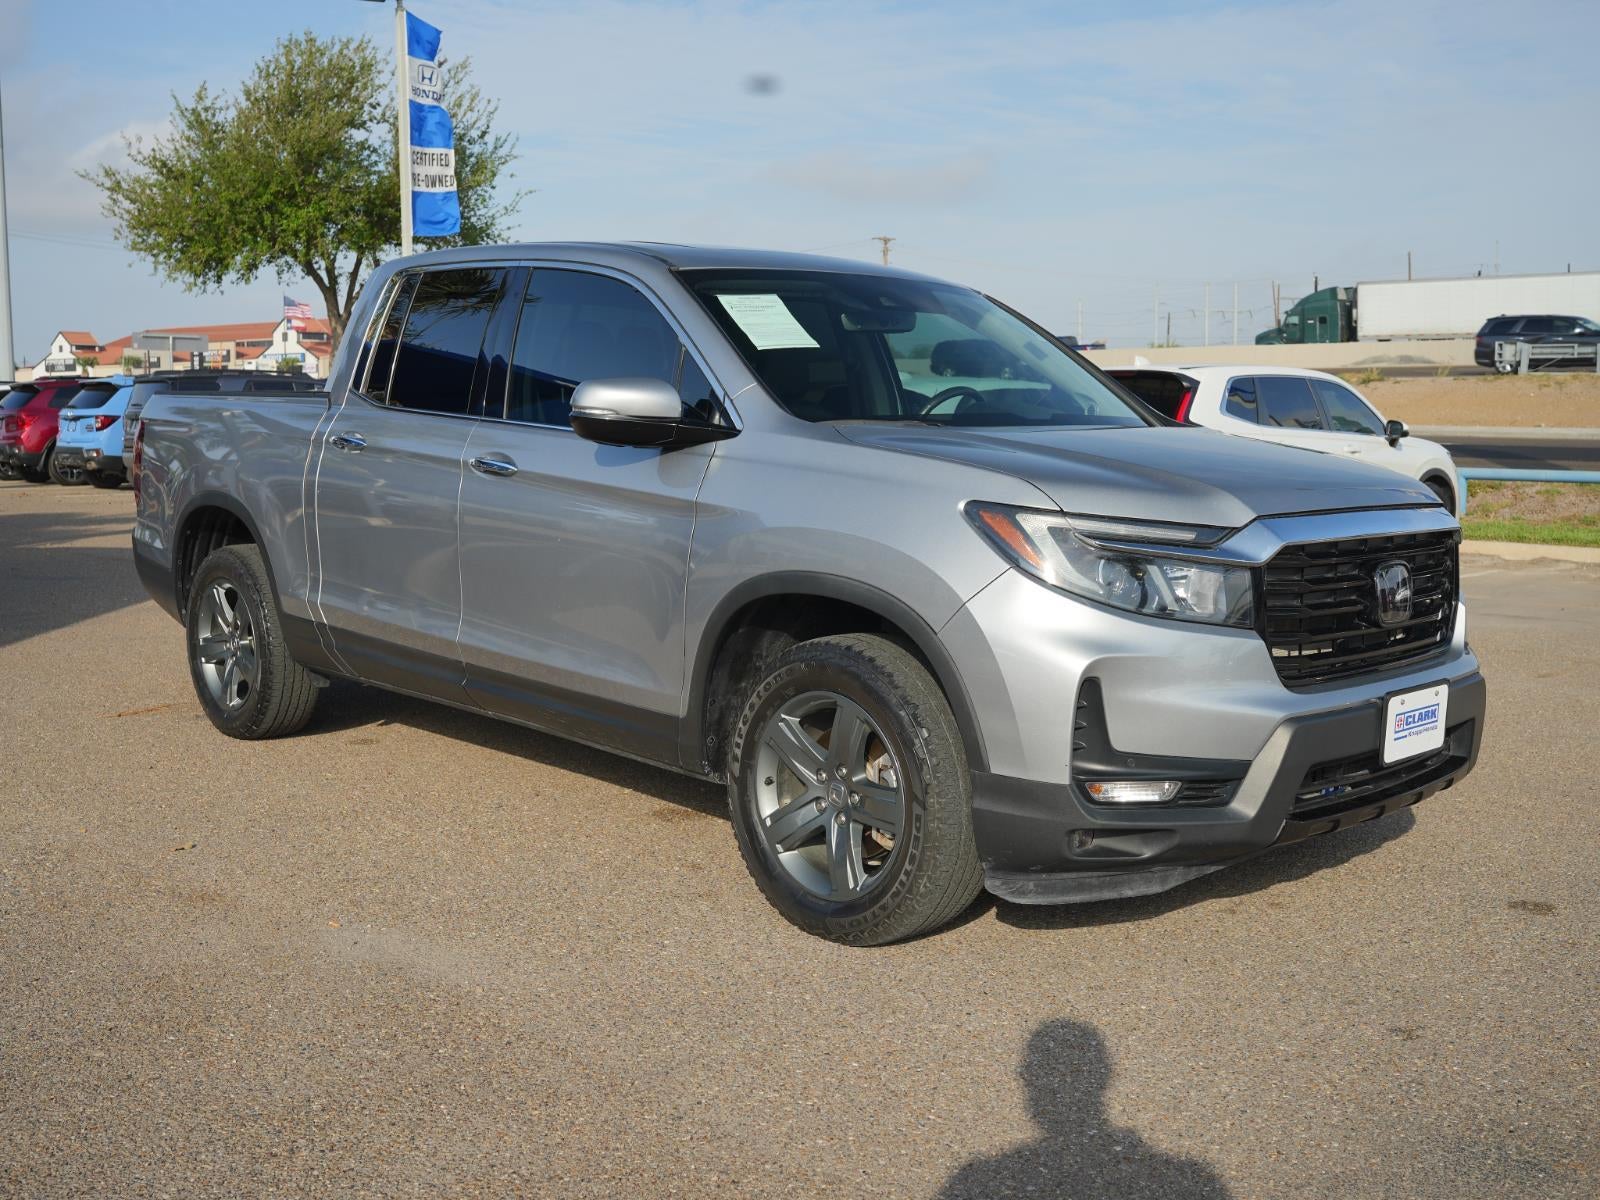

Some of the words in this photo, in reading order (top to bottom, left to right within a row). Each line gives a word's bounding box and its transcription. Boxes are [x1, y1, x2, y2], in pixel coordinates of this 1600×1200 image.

[412, 151, 450, 167] CERTIFIED
[411, 171, 455, 188] RE-OWNED
[1405, 708, 1437, 726] CLARK
